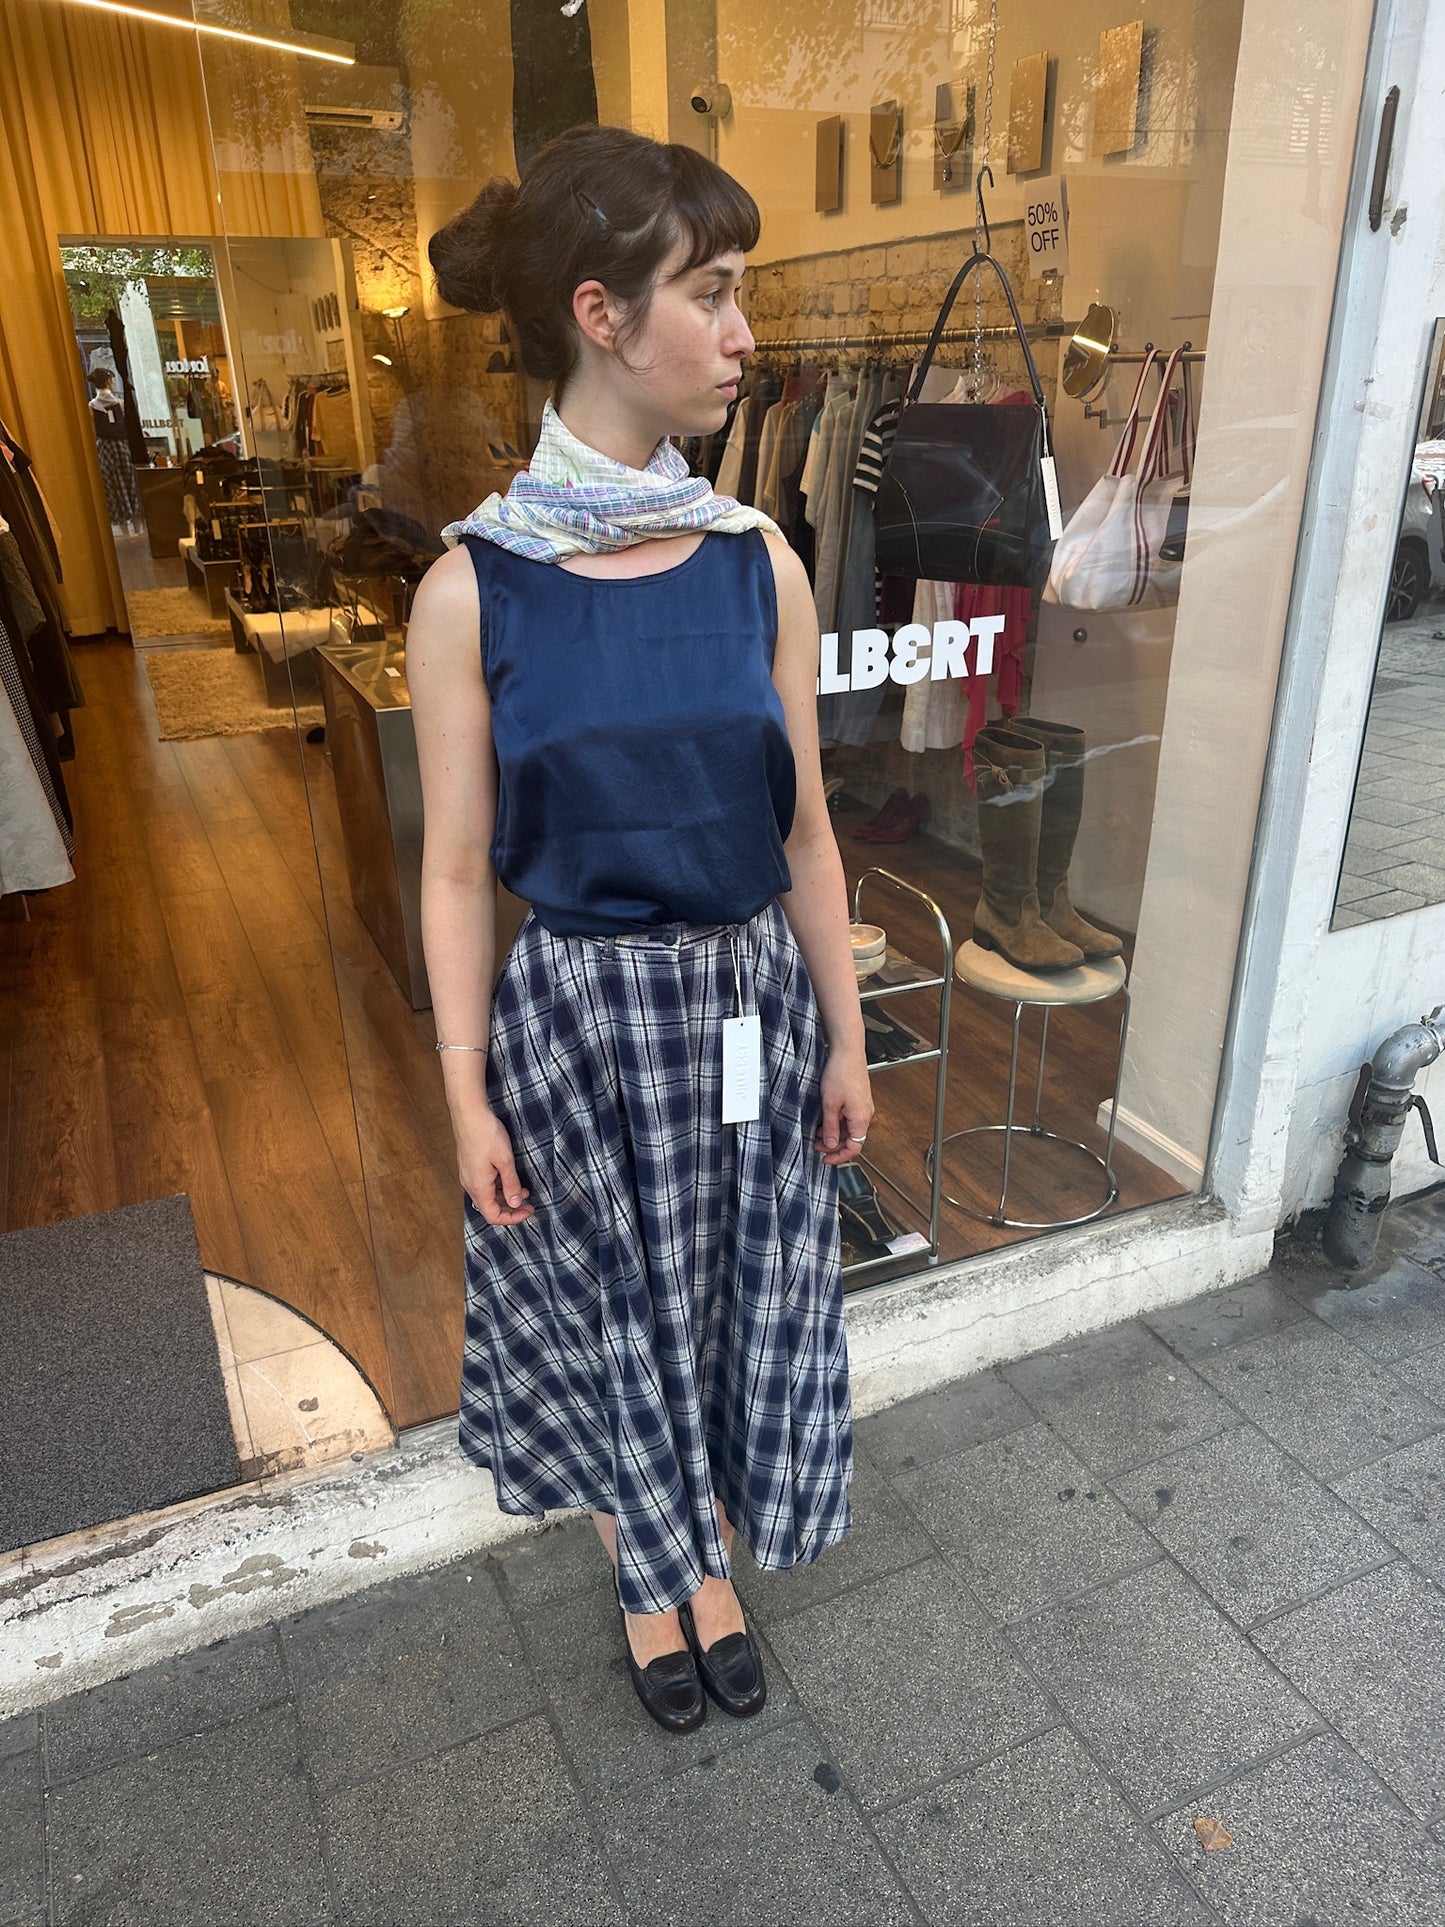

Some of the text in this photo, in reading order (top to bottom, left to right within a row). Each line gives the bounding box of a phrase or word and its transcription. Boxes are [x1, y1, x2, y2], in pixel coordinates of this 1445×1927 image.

[1028, 201, 1058, 227] 50%
[1031, 228, 1060, 252] OFF
[141, 418, 184, 429] JILLBET
[816, 614, 1006, 696] LBERT
